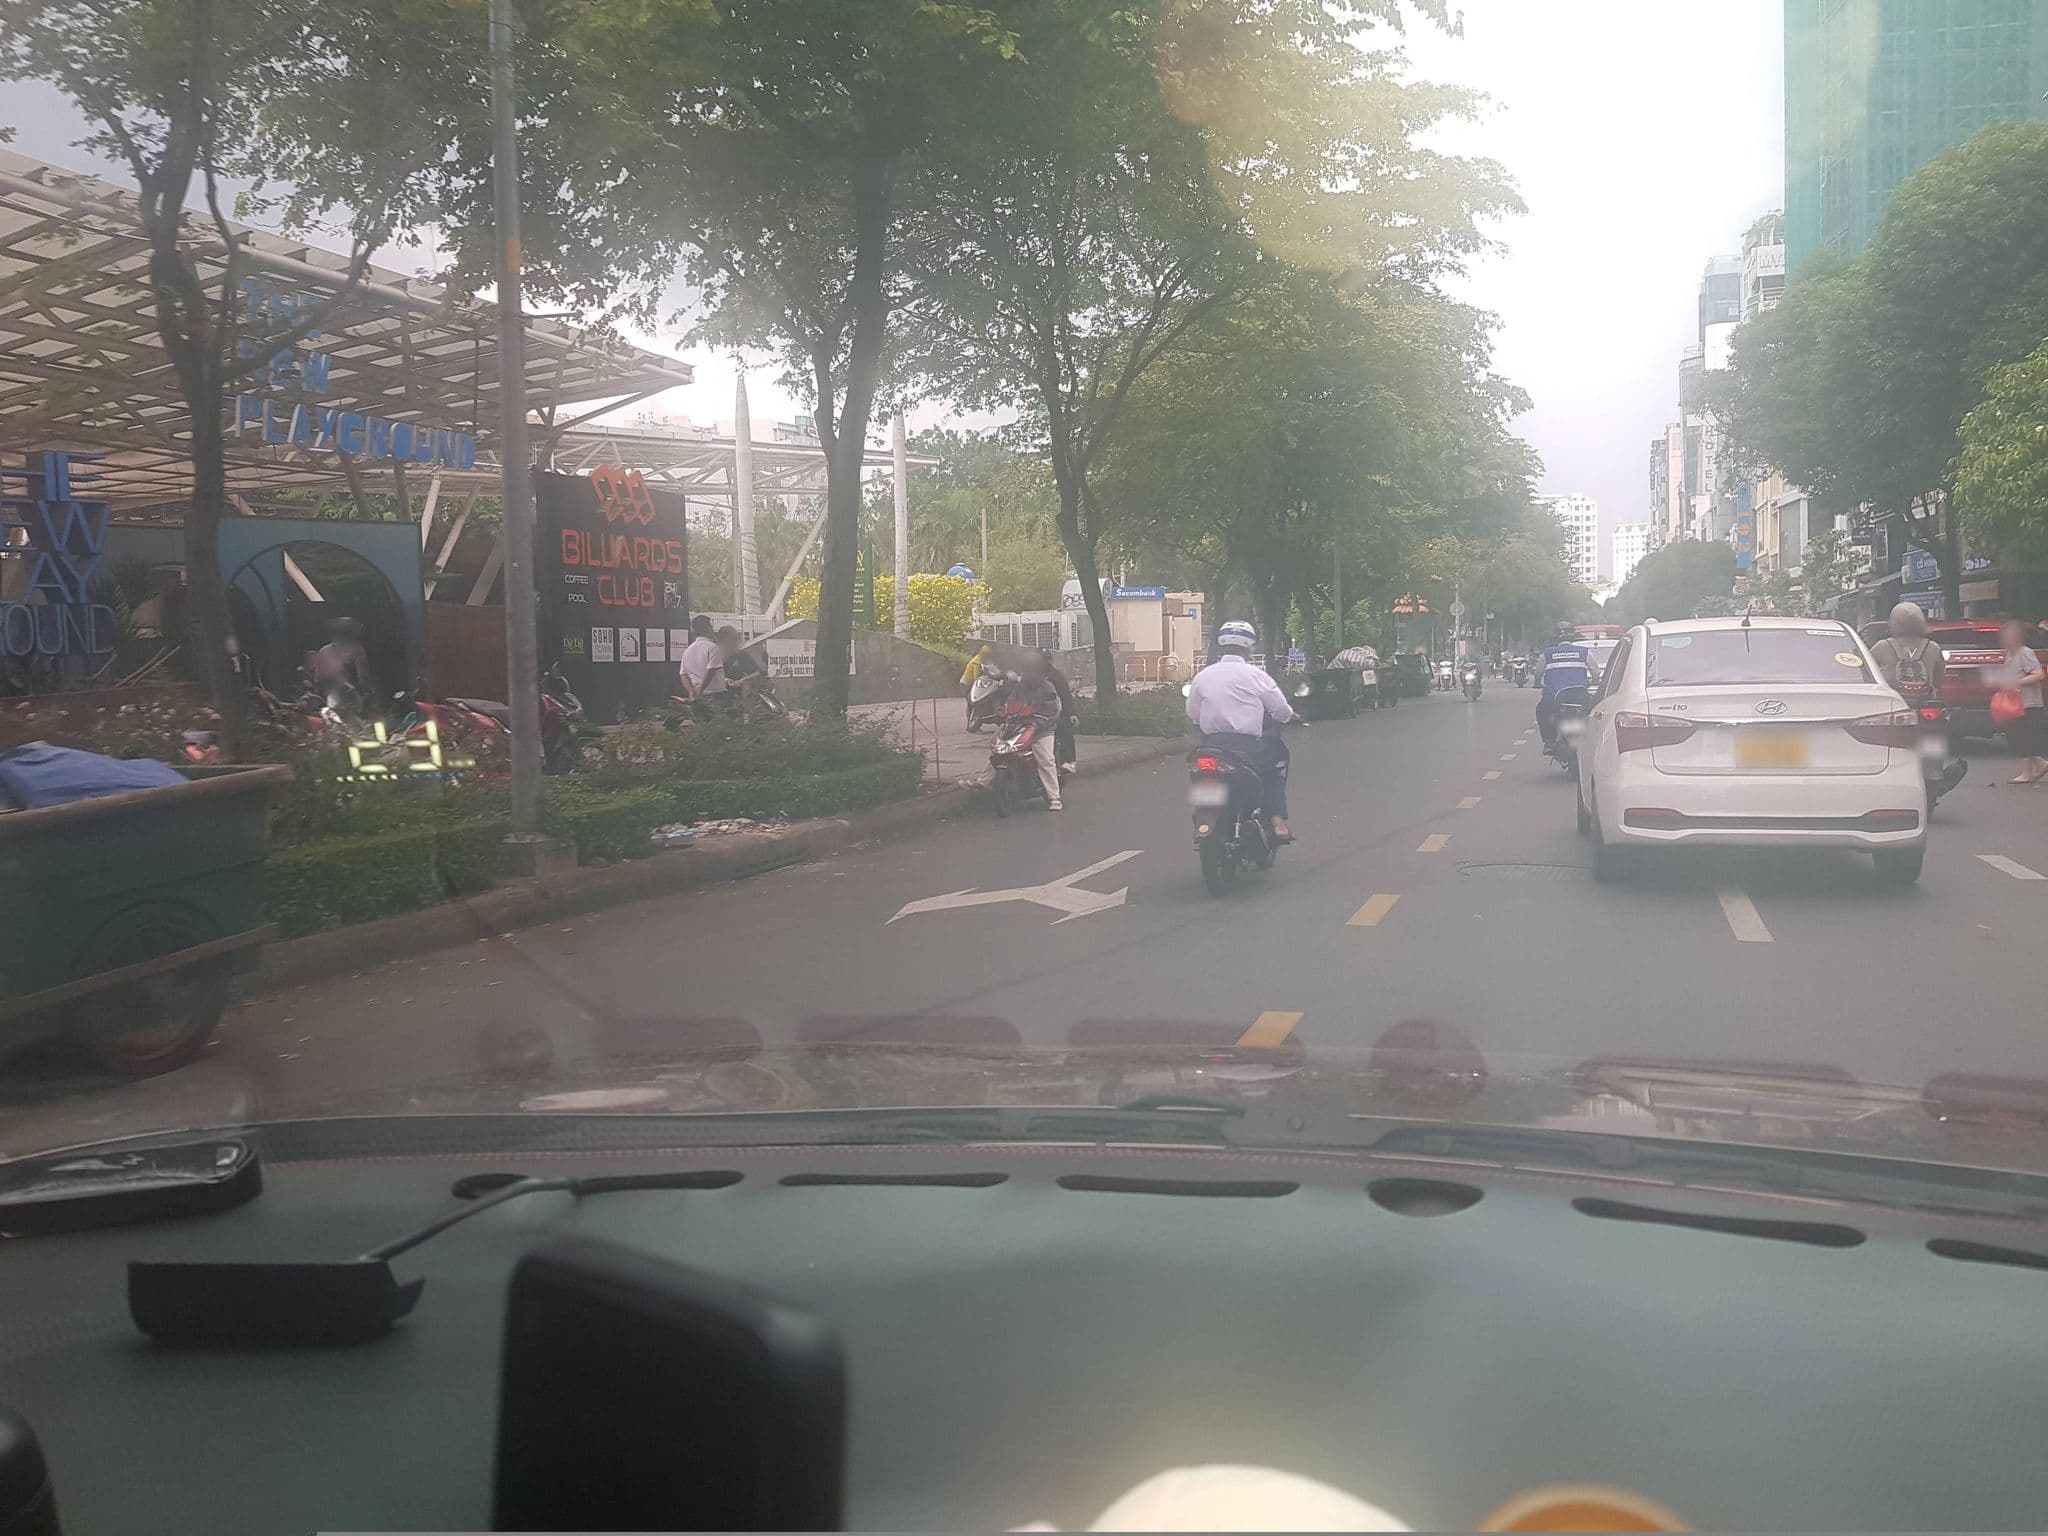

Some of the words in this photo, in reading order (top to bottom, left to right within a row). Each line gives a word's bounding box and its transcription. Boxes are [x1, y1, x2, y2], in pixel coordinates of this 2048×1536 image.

[234, 395, 476, 470] PLAYGROUND
[1705, 427, 1714, 492] HOTEL
[561, 528, 682, 574] BILLIARDS
[564, 574, 590, 584] COFFEE
[568, 593, 587, 603] POOL
[598, 575, 656, 607] CLUB
[1115, 588, 1157, 597] Sacombank
[592, 629, 613, 643] SOHO
